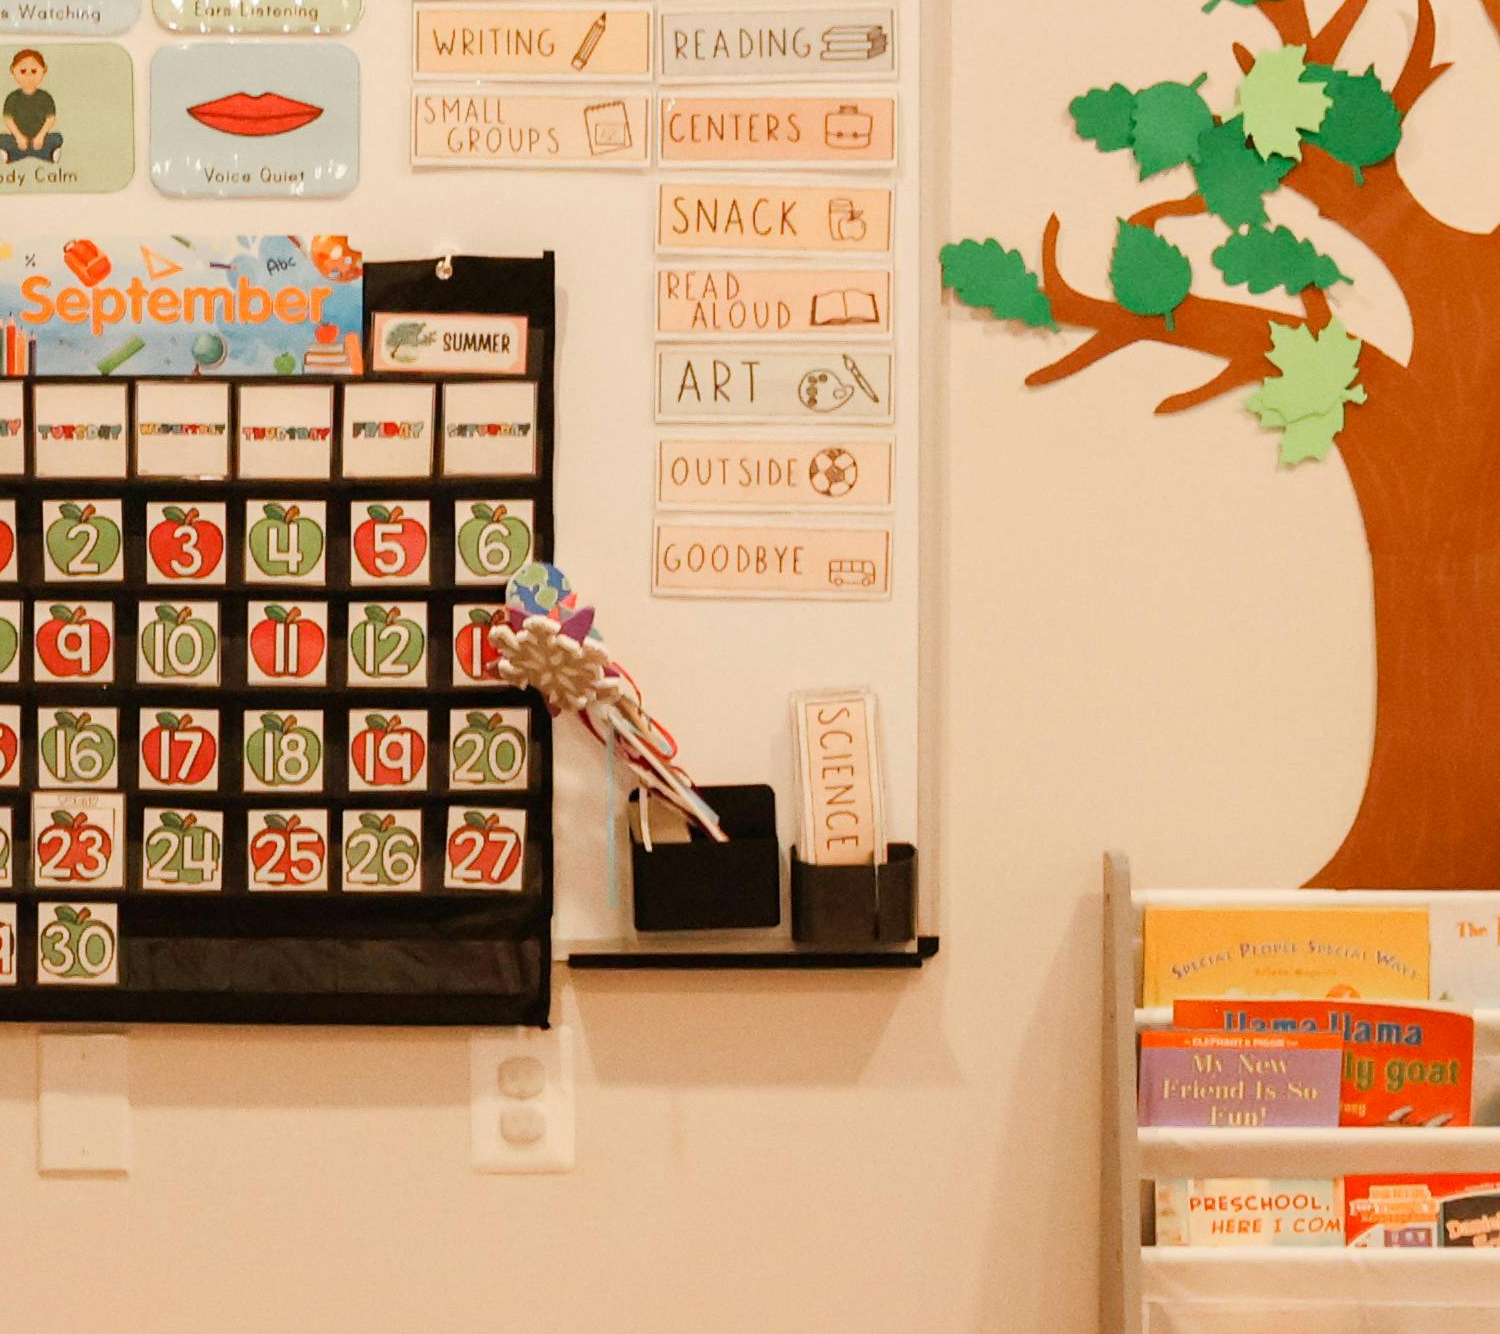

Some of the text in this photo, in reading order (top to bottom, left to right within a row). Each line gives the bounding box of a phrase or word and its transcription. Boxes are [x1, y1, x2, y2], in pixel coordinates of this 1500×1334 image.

[18, 2, 102, 25] Watching
[239, 1, 320, 23] Listening
[432, 27, 557, 57] WRITING
[673, 28, 812, 61] READING
[423, 97, 506, 126] SMALL
[446, 127, 562, 156] GROUPS
[669, 113, 803, 145] CENTERS
[34, 168, 79, 185] Calm
[203, 168, 306, 186] Voice Quiet
[671, 197, 799, 238] SNACK
[667, 271, 741, 303] READ
[19, 273, 333, 338] September
[691, 300, 794, 331] ALOUD
[442, 331, 511, 355] SUMMER
[676, 359, 762, 404] ART
[669, 457, 799, 488] OUTSIDE
[67, 523, 100, 573] 2
[170, 524, 203, 576] 3
[267, 522, 304, 573] 4
[373, 522, 407, 574] 5
[477, 522, 511, 573] 6
[662, 543, 806, 577] GOODBYE
[153, 622, 203, 675] 10
[453, 731, 523, 782] 20
[816, 706, 861, 852] SCIENCE
[40, 828, 108, 879] 23
[254, 832, 322, 883] 25
[451, 830, 517, 881] 27
[42, 924, 113, 974] 30
[1238, 1053, 1288, 1074] New
[1384, 1054, 1461, 1092] goat
[1162, 1079, 1245, 1100] Friend
[1210, 1218, 1262, 1234] HERE
